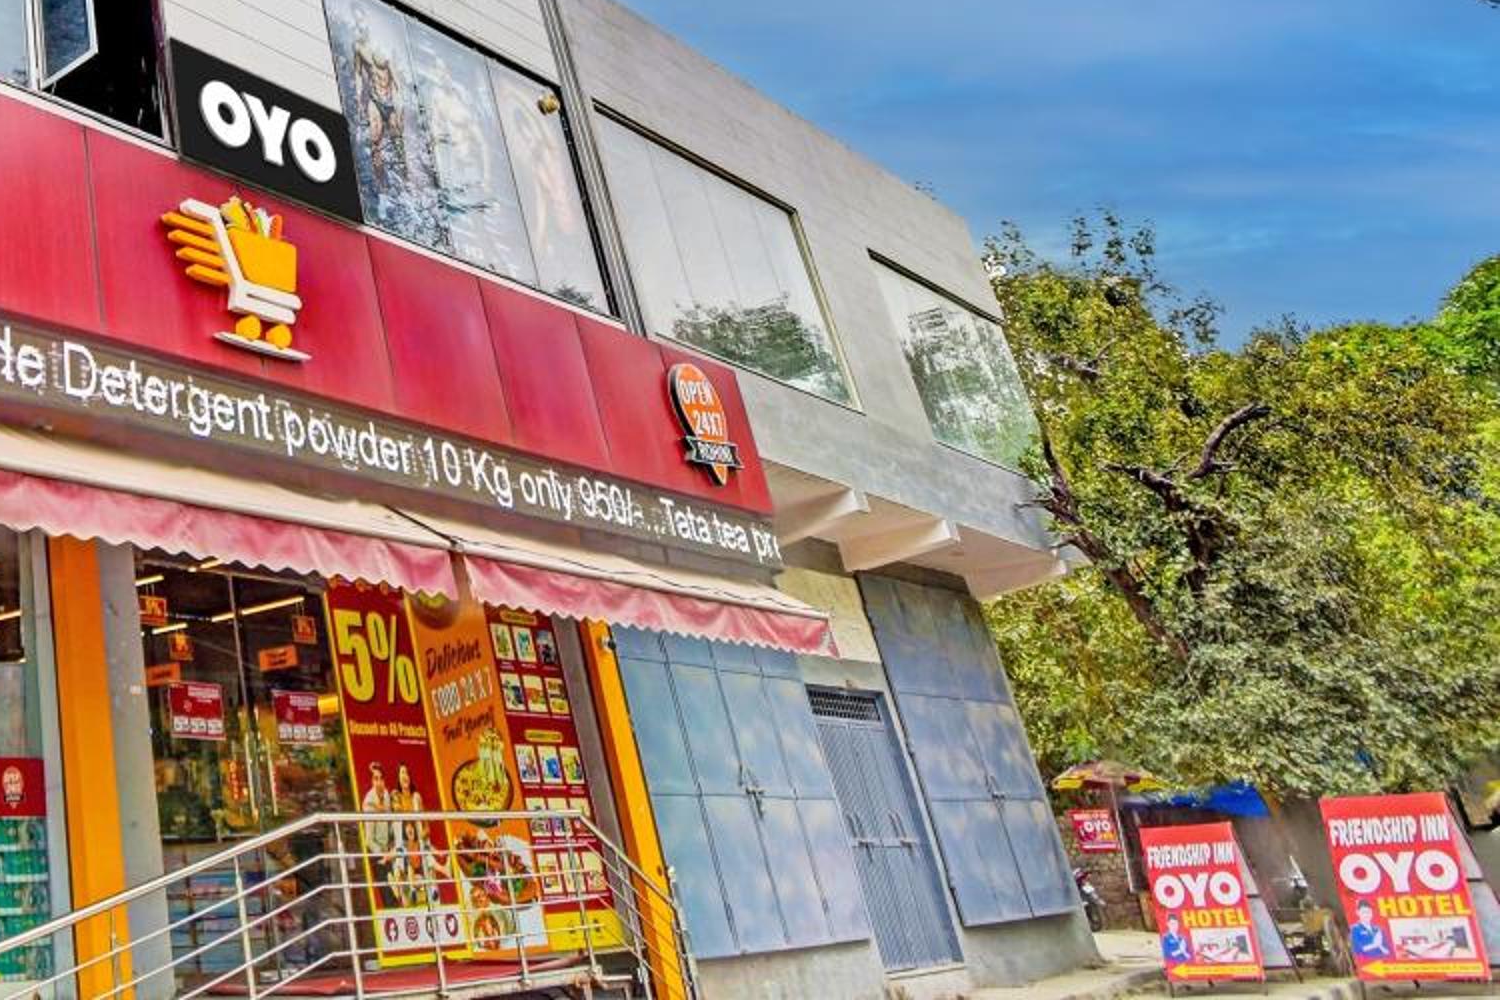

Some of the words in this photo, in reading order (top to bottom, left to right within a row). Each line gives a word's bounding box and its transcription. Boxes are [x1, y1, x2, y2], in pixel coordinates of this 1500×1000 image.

[200, 80, 337, 183] OYO
[680, 381, 714, 405] OPEN
[62, 340, 275, 438] Detergent
[283, 406, 413, 475] powder
[424, 437, 461, 487] 10
[467, 447, 513, 509] Kg
[519, 468, 572, 521] only
[712, 513, 751, 553] tea
[333, 609, 419, 704] 5%
[1083, 820, 1111, 832] OYO
[1328, 815, 1417, 847] FRIENDSHIP
[1420, 814, 1449, 842] INN
[1148, 843, 1211, 868] FRIENDSHIP
[1212, 842, 1235, 864] INN
[1339, 850, 1458, 894] OYO
[1155, 871, 1241, 909] OYO
[1377, 895, 1471, 917] HOTEL
[1180, 908, 1250, 928] HOTEL
